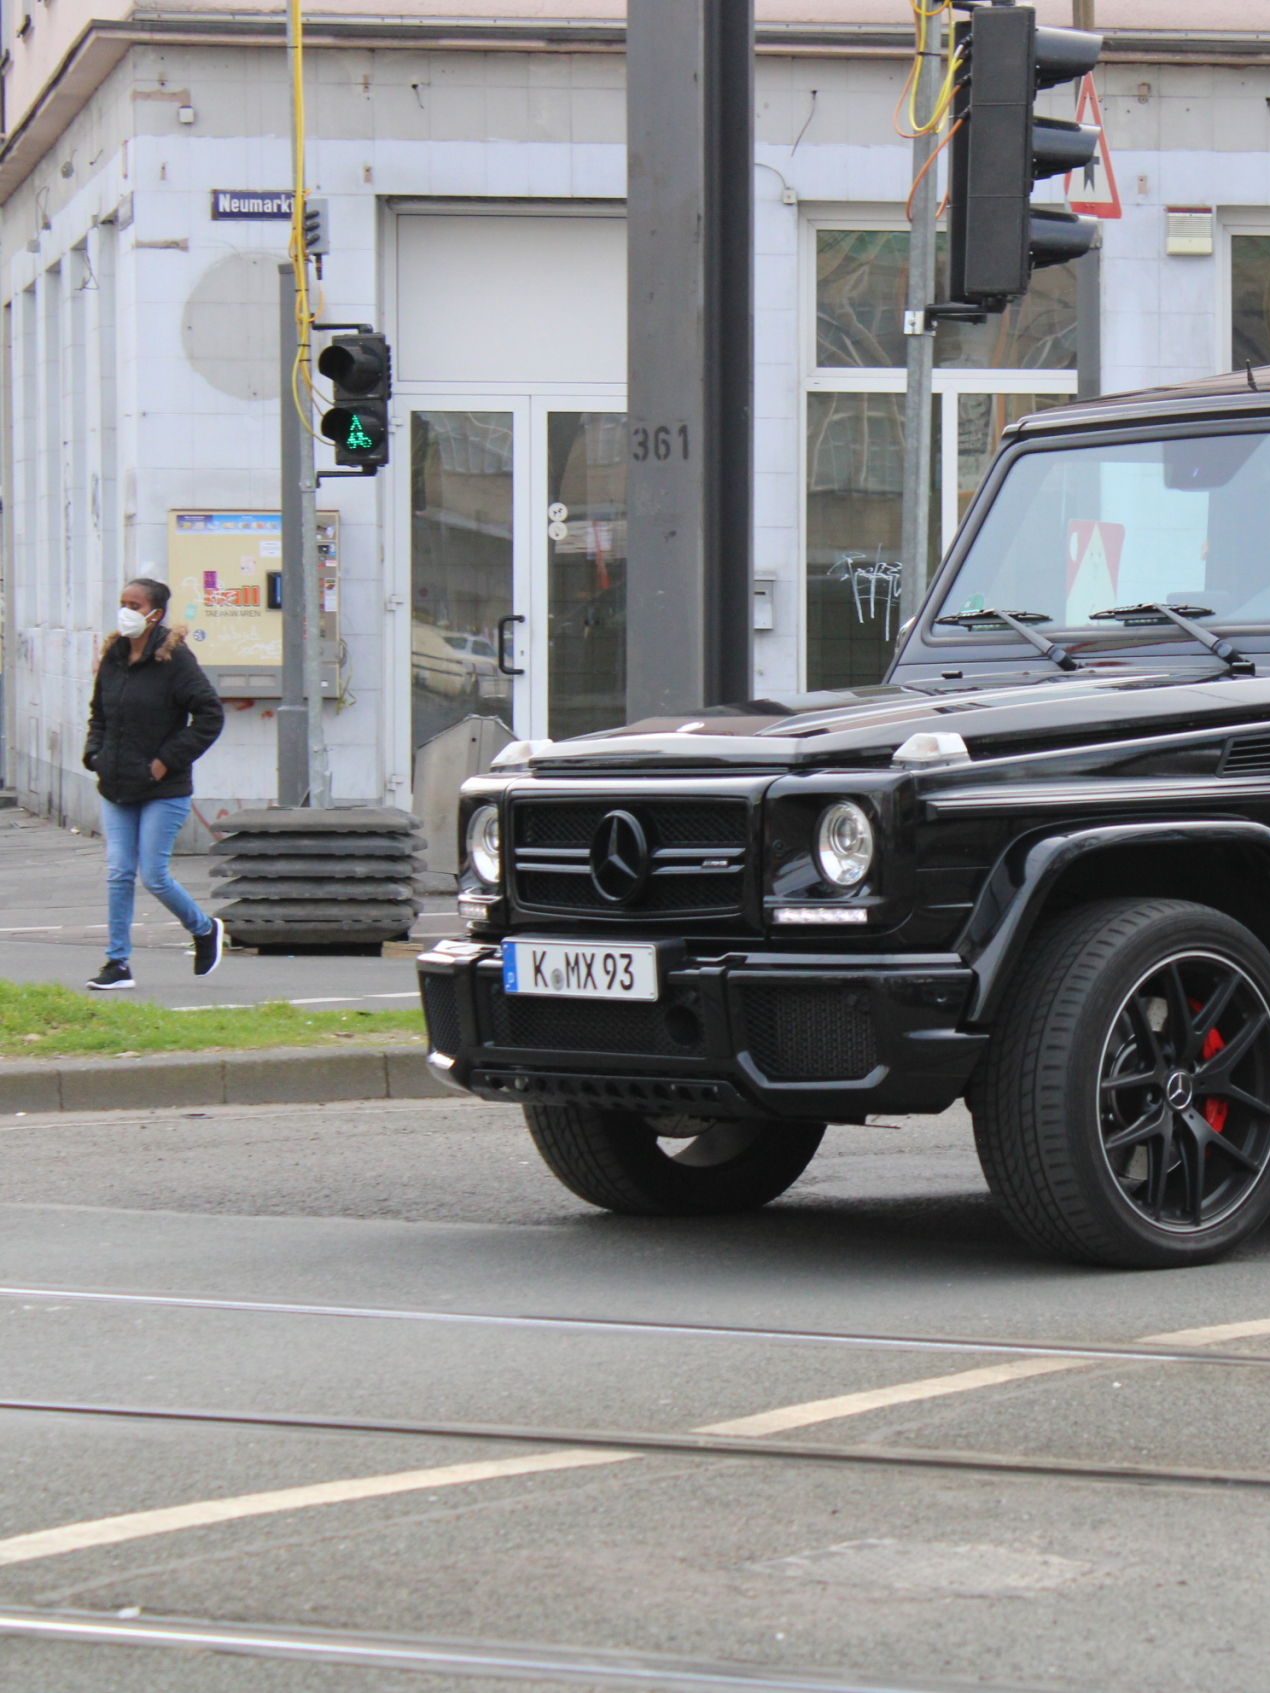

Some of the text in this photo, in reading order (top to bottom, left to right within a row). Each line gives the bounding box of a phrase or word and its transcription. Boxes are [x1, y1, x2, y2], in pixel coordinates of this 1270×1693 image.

[632, 424, 689, 462] 361
[532, 949, 635, 991] K MX 93
